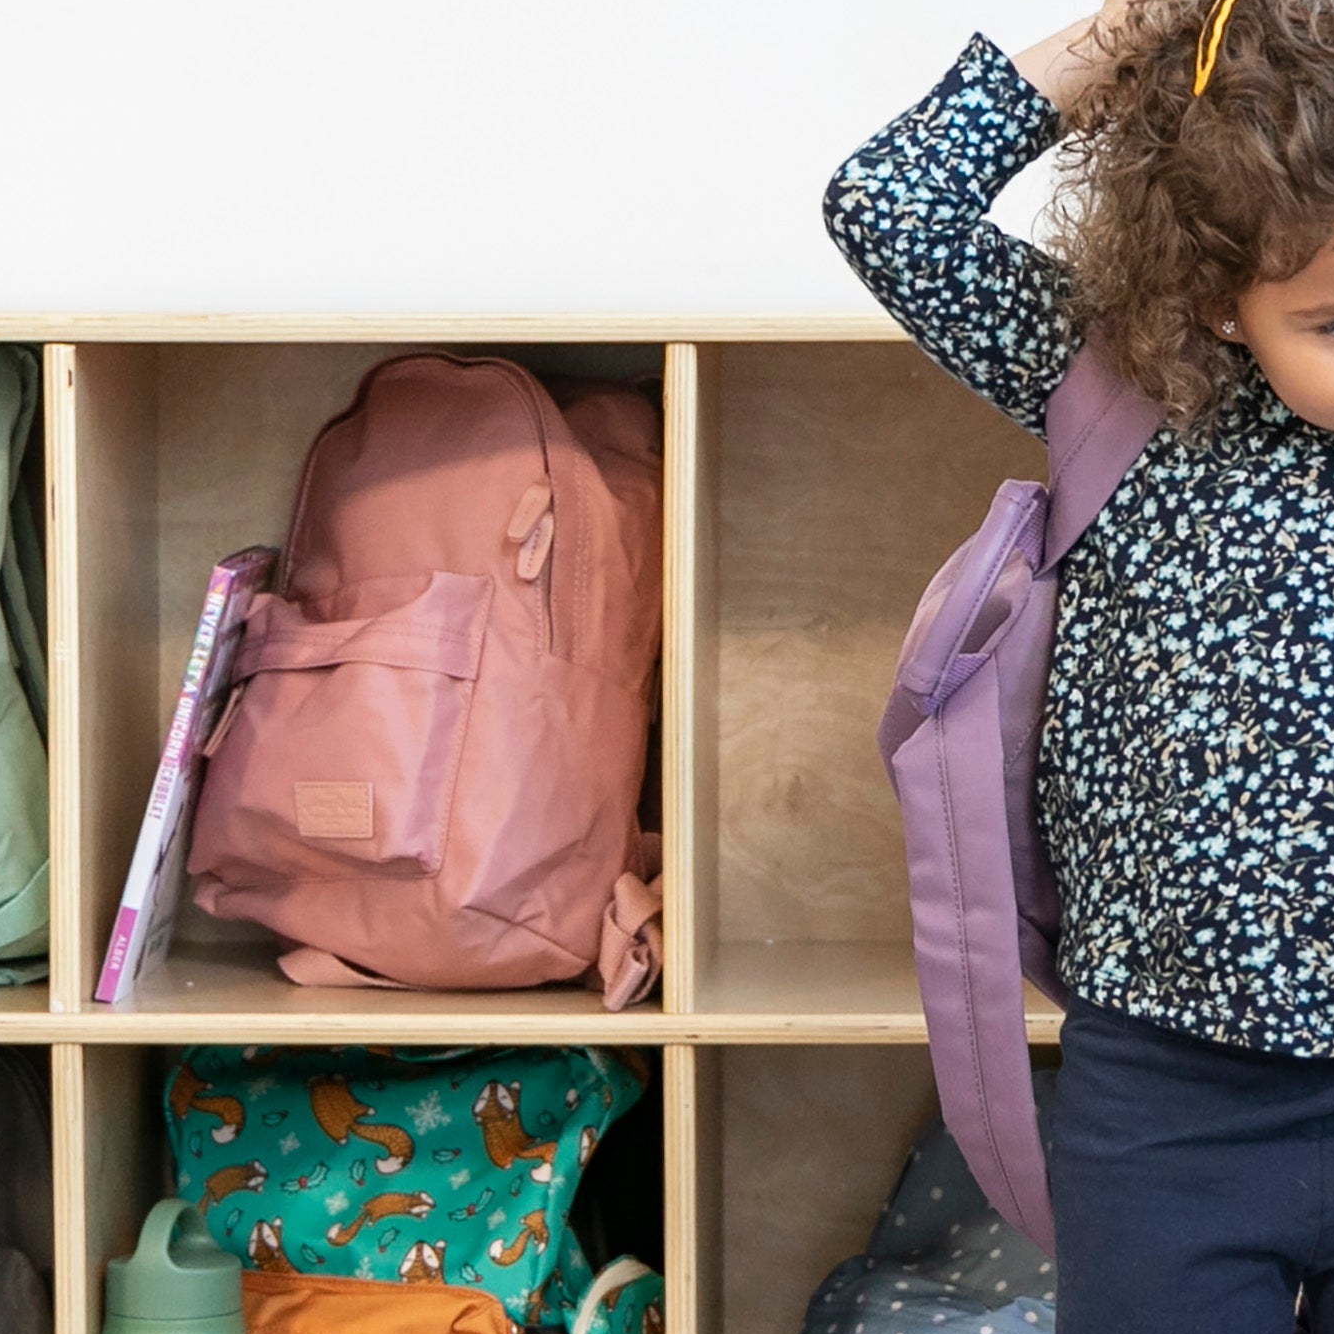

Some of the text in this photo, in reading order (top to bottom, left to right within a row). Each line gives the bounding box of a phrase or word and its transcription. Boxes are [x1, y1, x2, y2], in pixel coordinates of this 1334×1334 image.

[194, 592, 225, 647] NEVER
[186, 648, 210, 682] LET
[165, 696, 195, 762] UNICORN
